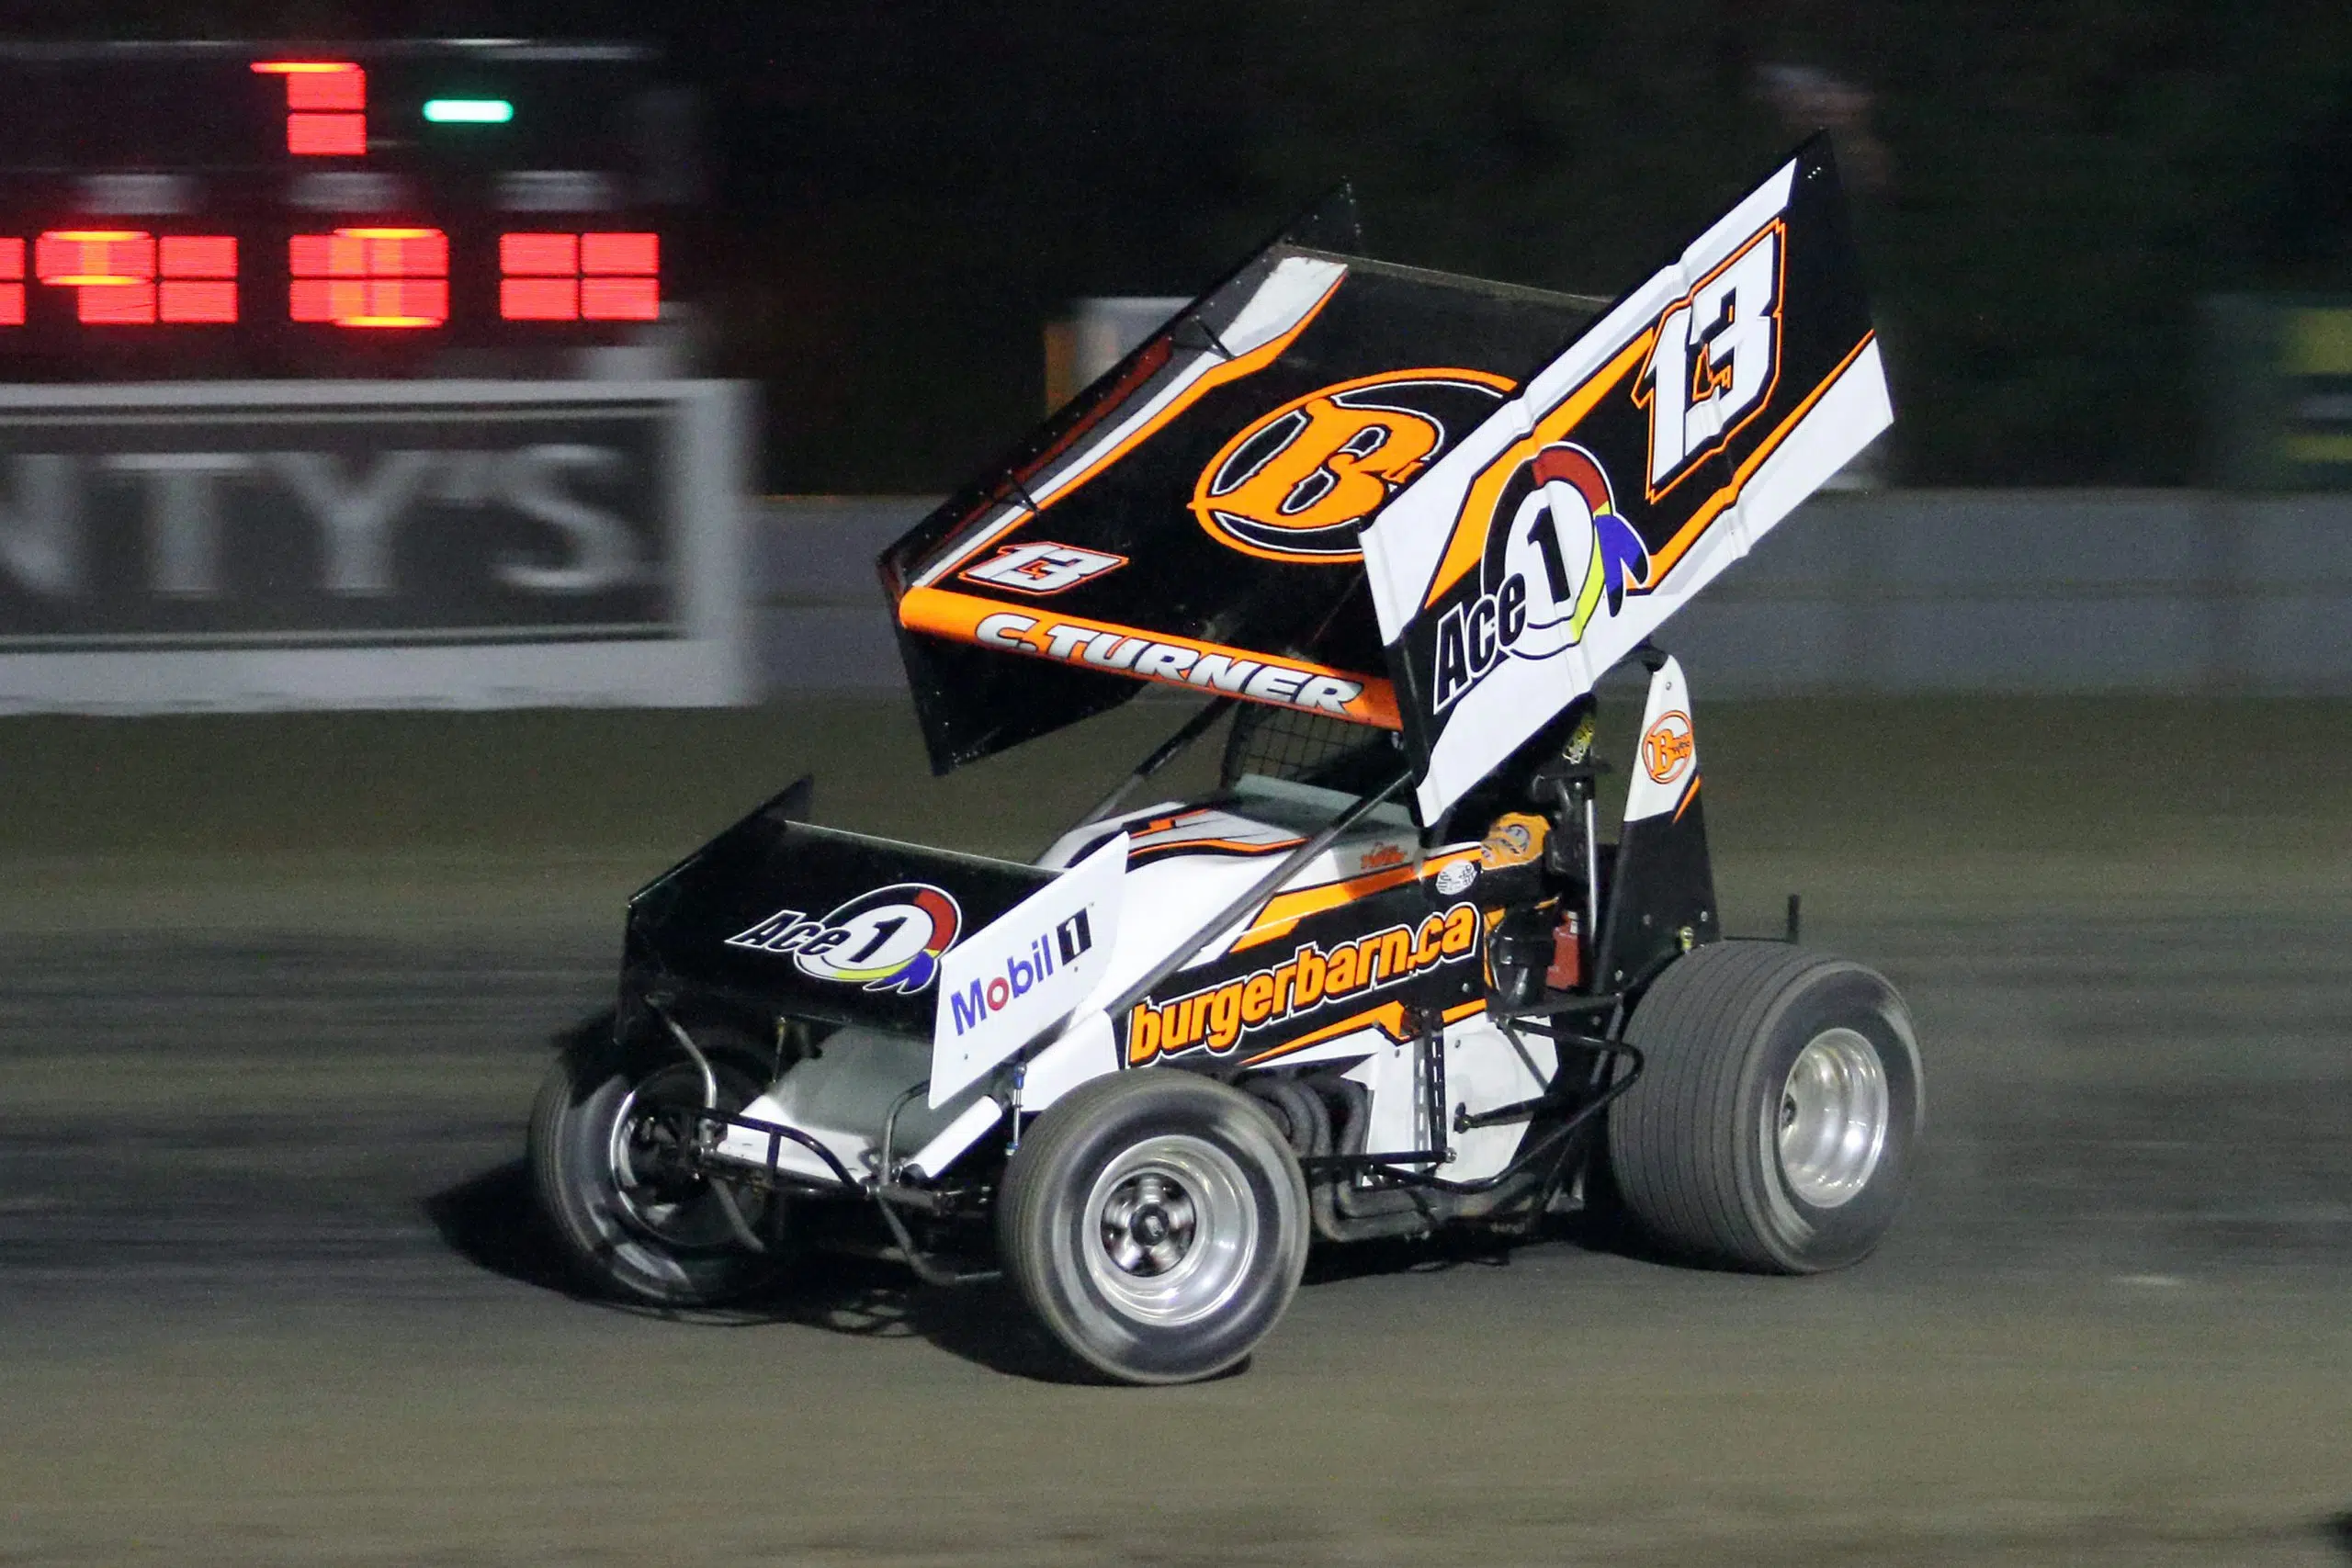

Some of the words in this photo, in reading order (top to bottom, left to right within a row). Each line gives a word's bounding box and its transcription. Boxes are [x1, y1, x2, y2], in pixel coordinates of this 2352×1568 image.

[1637, 222, 1781, 497] 13
[963, 542, 1125, 594] 13
[1434, 571, 1527, 715] Ace
[1527, 502, 1572, 604] 1
[976, 613, 1364, 715] C.TURNER
[725, 910, 852, 956] Ace
[848, 917, 908, 963] 1
[951, 933, 1054, 1036] Mobil
[1128, 905, 1478, 1066] burgerbarn.ca
